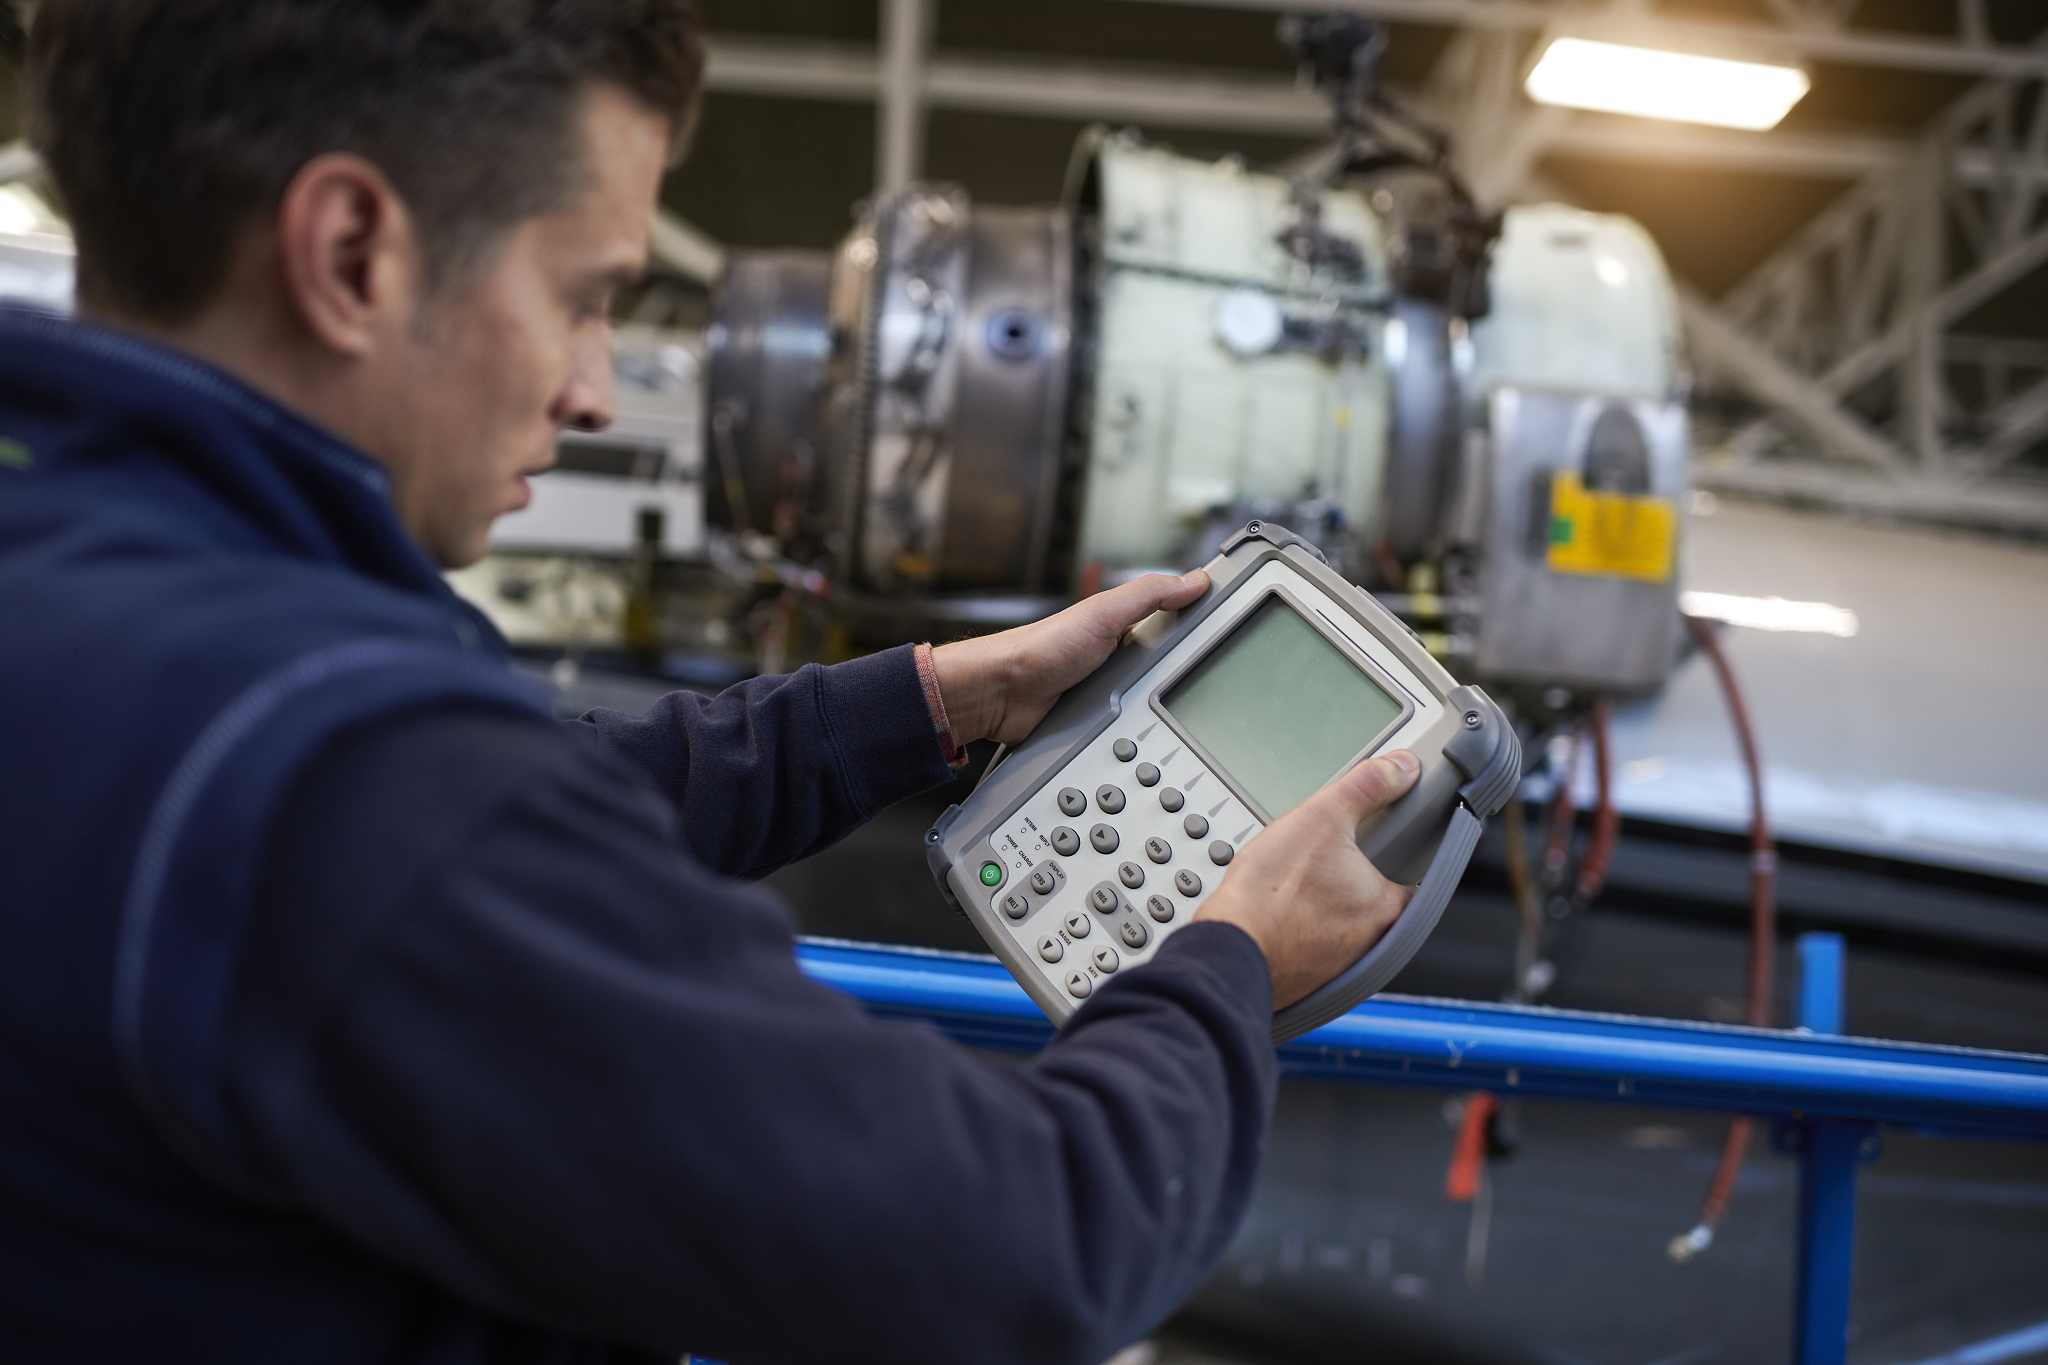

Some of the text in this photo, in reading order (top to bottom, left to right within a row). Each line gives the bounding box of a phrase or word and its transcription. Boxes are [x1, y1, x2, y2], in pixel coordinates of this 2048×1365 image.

[1005, 834, 1018, 849] POWER
[1039, 834, 1051, 847] REPLY
[1149, 840, 1163, 854] XPDR
[1019, 850, 1034, 867] CHARGE
[1049, 862, 1065, 880] DISPLAY
[1123, 865, 1135, 878] DME
[1034, 873, 1045, 885] CTRS
[1179, 872, 1192, 886] TCAS
[1007, 897, 1019, 909] BKLT
[1095, 890, 1108, 904] FREQ
[1150, 897, 1165, 912] SETUP
[1123, 922, 1137, 939] RF LVL
[1058, 930, 1072, 946] RANGE
[1087, 966, 1099, 979] RATE
